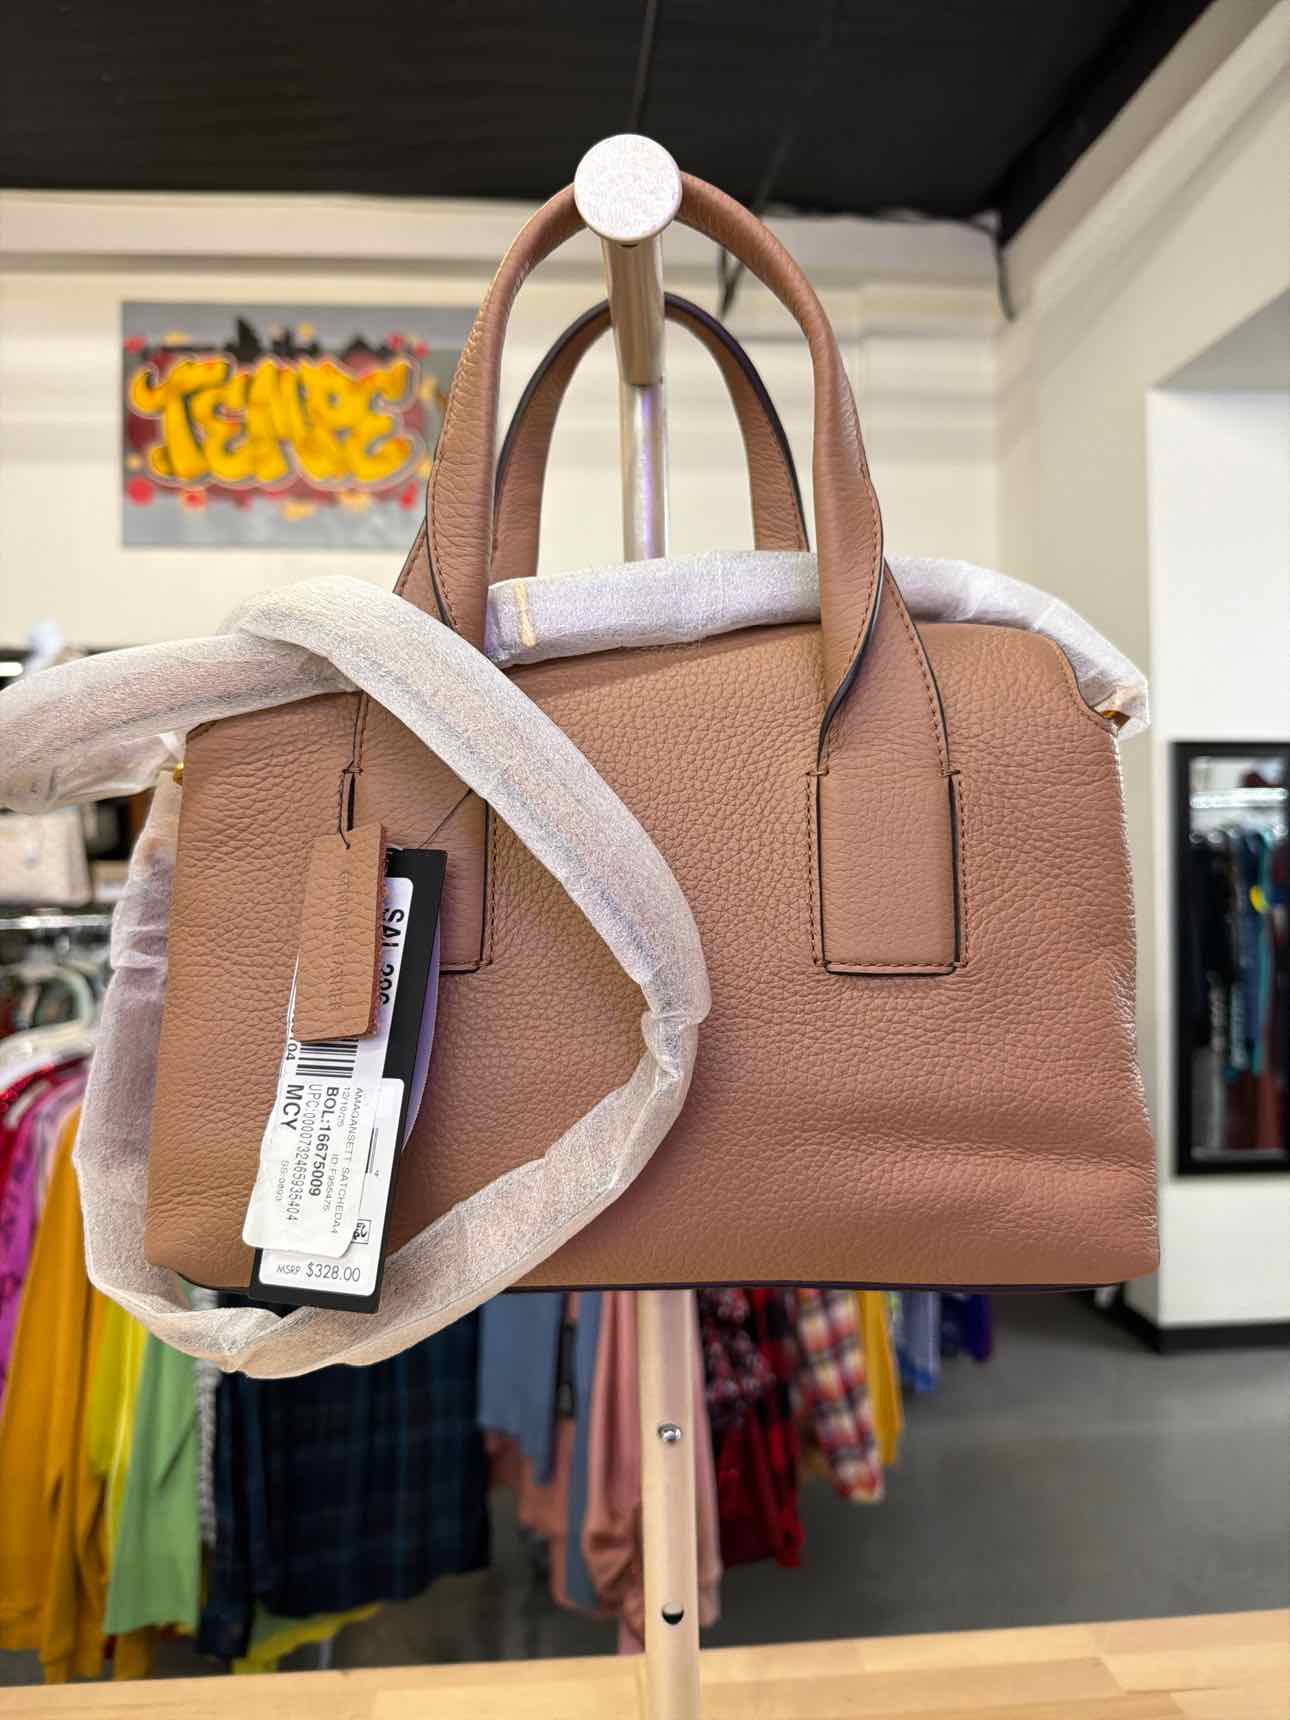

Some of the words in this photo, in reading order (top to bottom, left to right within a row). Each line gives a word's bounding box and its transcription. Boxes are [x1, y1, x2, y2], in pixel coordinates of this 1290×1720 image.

[129, 355, 417, 484] TEMPE
[281, 1084, 305, 1130] MCY
[309, 1086, 340, 1197] BOL:16675009
[276, 1263, 301, 1275] MSRP
[305, 1261, 361, 1282] $328.00
